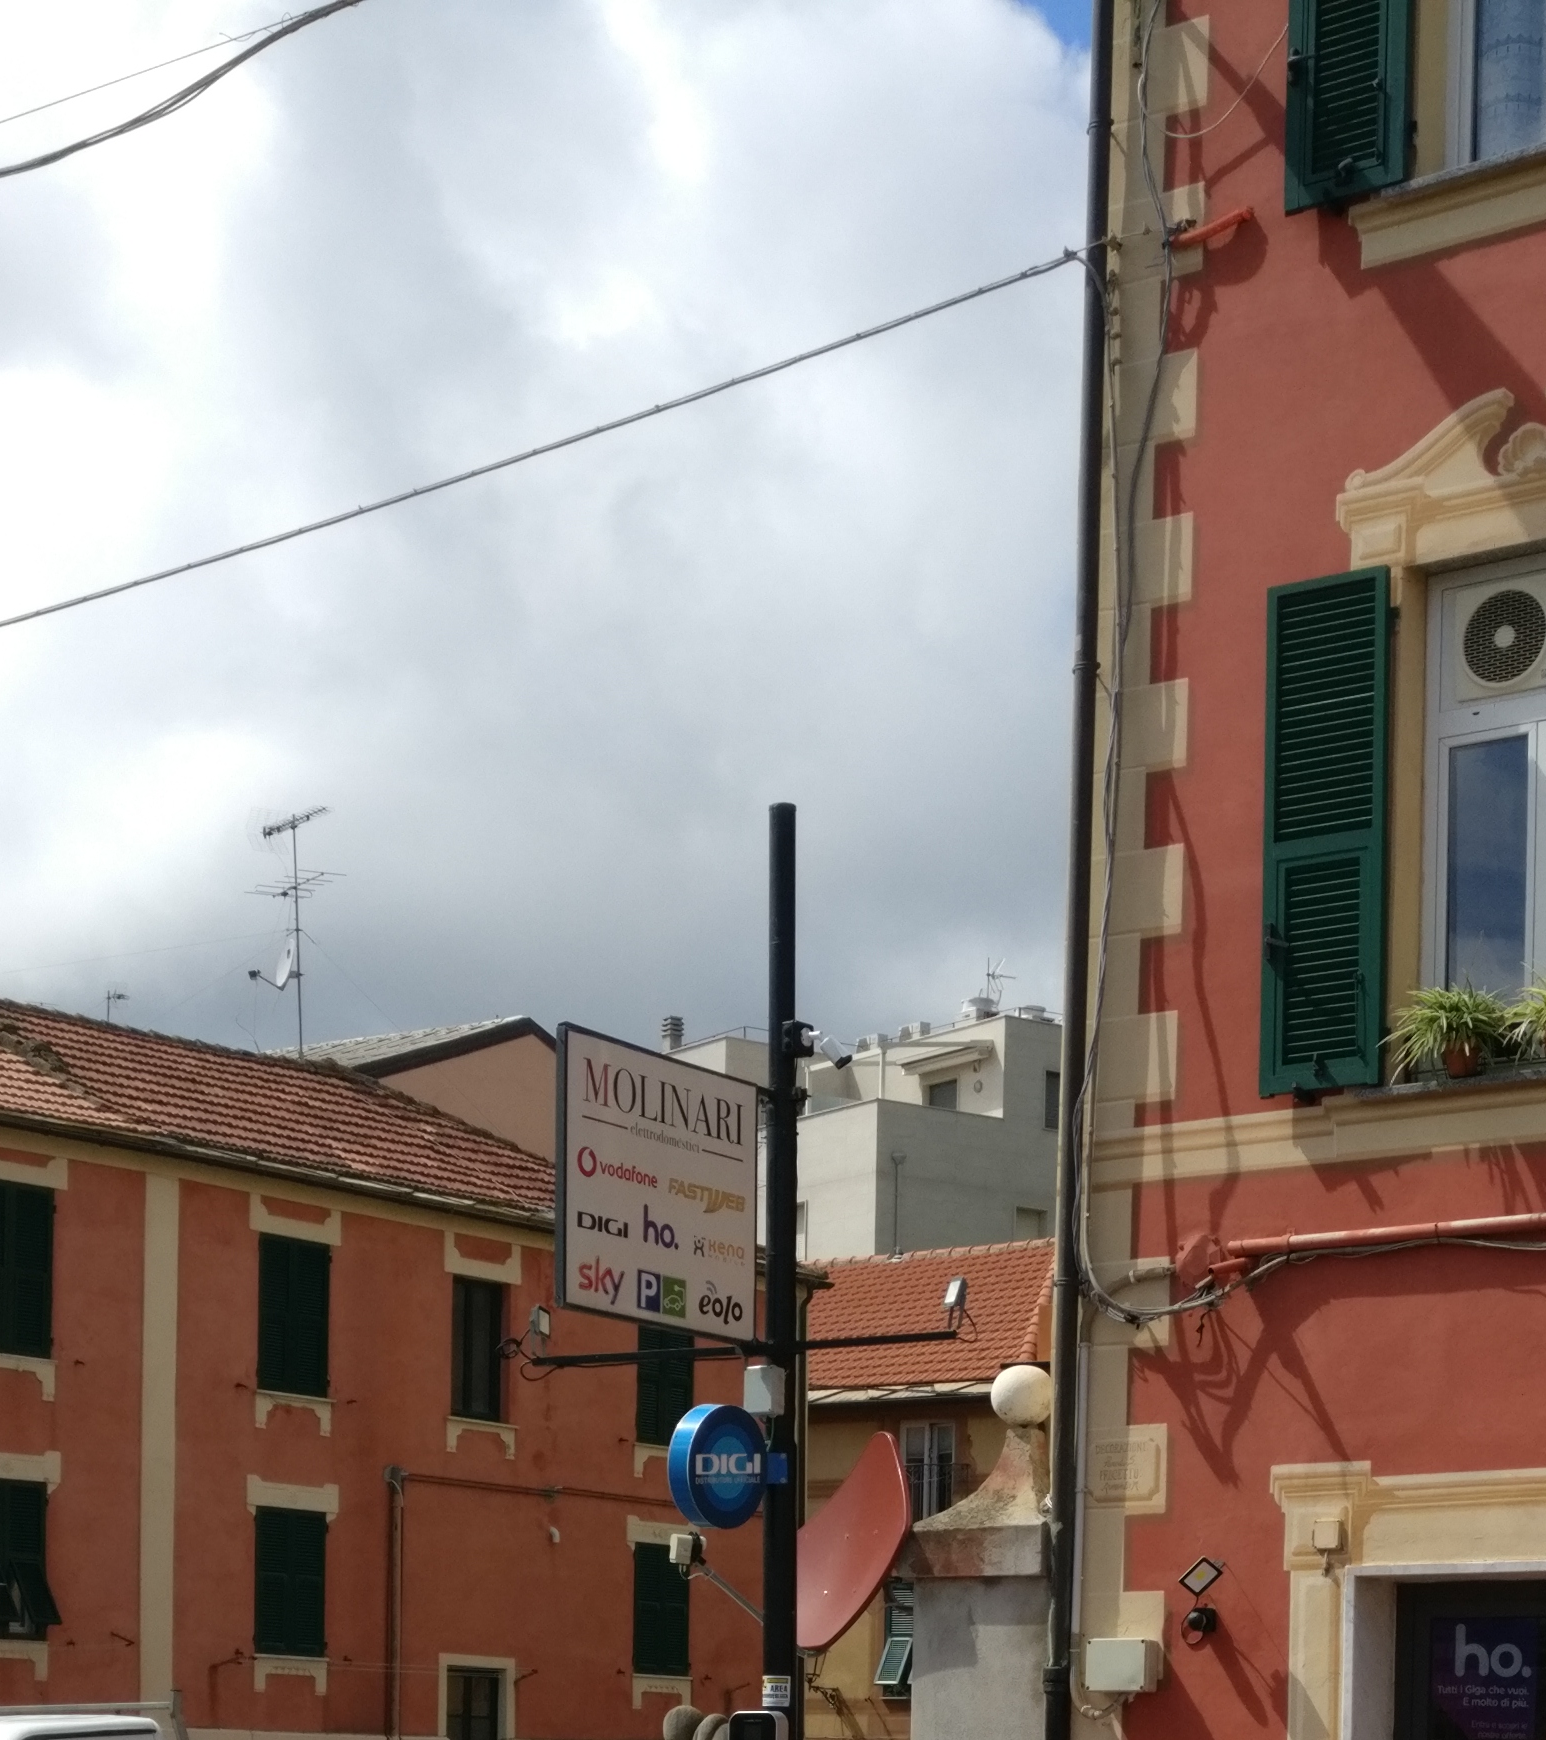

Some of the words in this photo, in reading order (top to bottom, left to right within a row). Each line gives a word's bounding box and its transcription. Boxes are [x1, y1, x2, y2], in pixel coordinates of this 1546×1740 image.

[583, 1057, 743, 1147] MOLINARI
[630, 1121, 701, 1155] elettrodomestici
[599, 1160, 658, 1189] vodafone
[669, 1178, 745, 1213] FASTWEB
[577, 1211, 628, 1238] DIGI
[643, 1203, 679, 1251] ho.
[578, 1256, 625, 1306] sky
[699, 1294, 743, 1325] eolo
[695, 1453, 761, 1475] DIGI
[1455, 1623, 1532, 1678] ho.
[771, 1684, 789, 1693] AREA
[1437, 1685, 1457, 1694] Tutti
[1465, 1685, 1486, 1696] Giga
[1488, 1685, 1505, 1694] che
[1508, 1686, 1530, 1695] vuoi.
[1463, 1697, 1470, 1706] E
[1471, 1697, 1499, 1706] molto
[1500, 1697, 1510, 1706] di
[1512, 1697, 1529, 1709] più.
